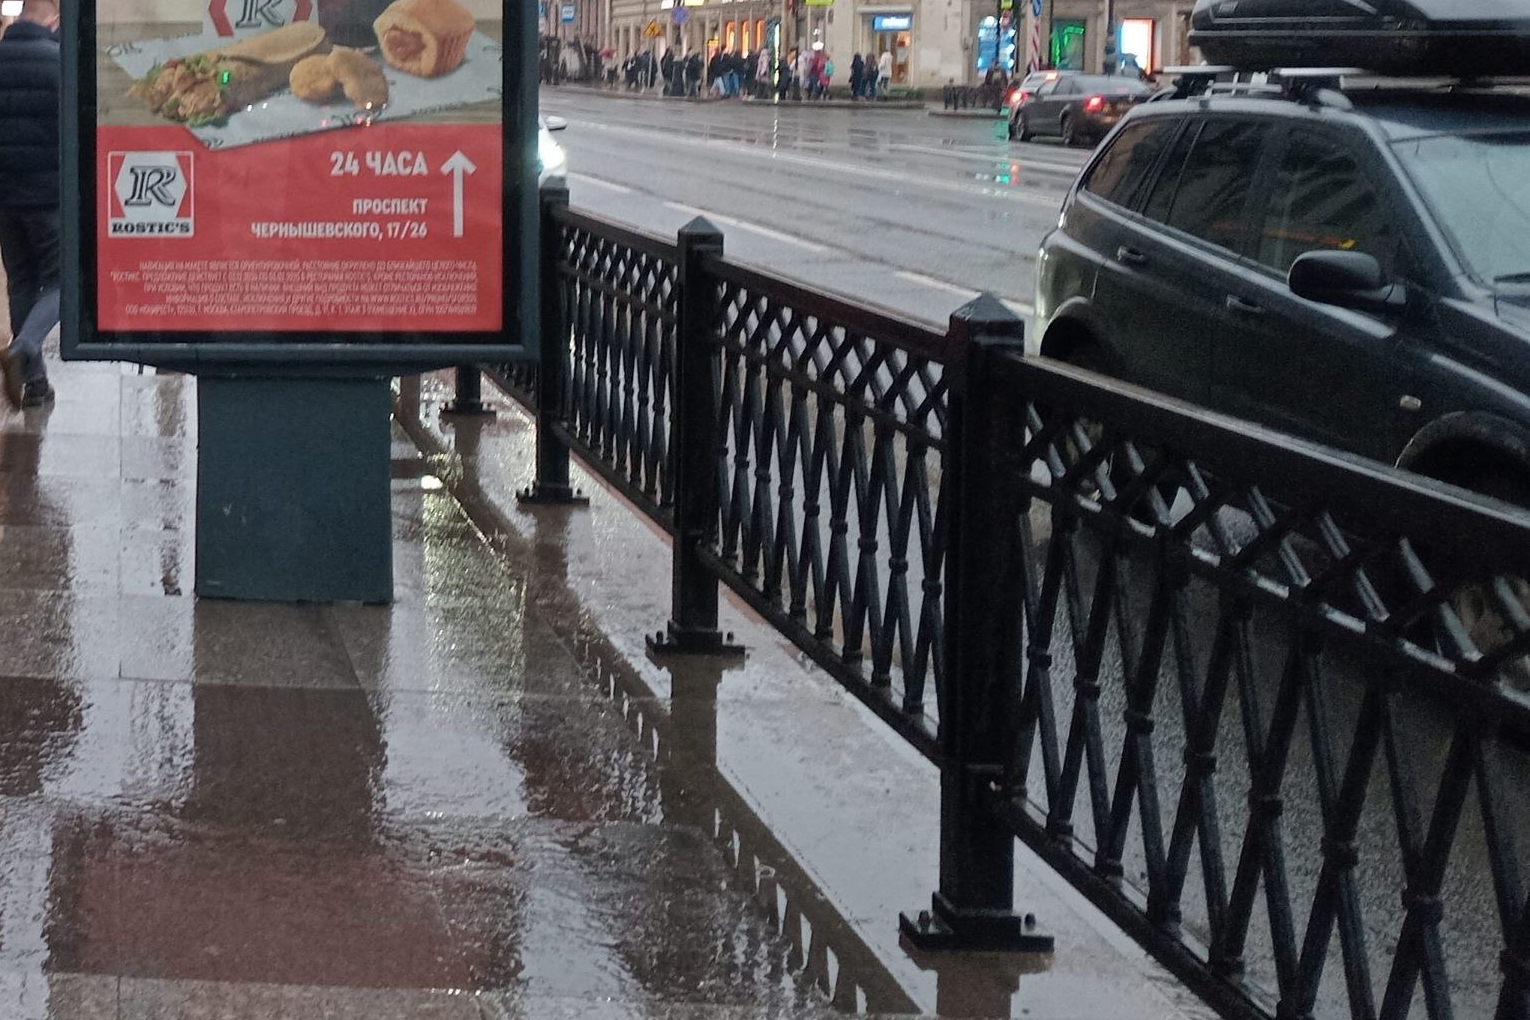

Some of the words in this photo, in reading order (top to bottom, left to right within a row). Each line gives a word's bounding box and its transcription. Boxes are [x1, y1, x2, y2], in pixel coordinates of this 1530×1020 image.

[330, 151, 360, 176] 24
[366, 151, 428, 176] ЧАСА
[352, 198, 428, 215] ПРОСПЕКТ
[112, 221, 190, 233] ROSTIC'S
[251, 222, 384, 241] ЧЕРНЫШЕВСКОГО,
[387, 220, 428, 240] 17/26
